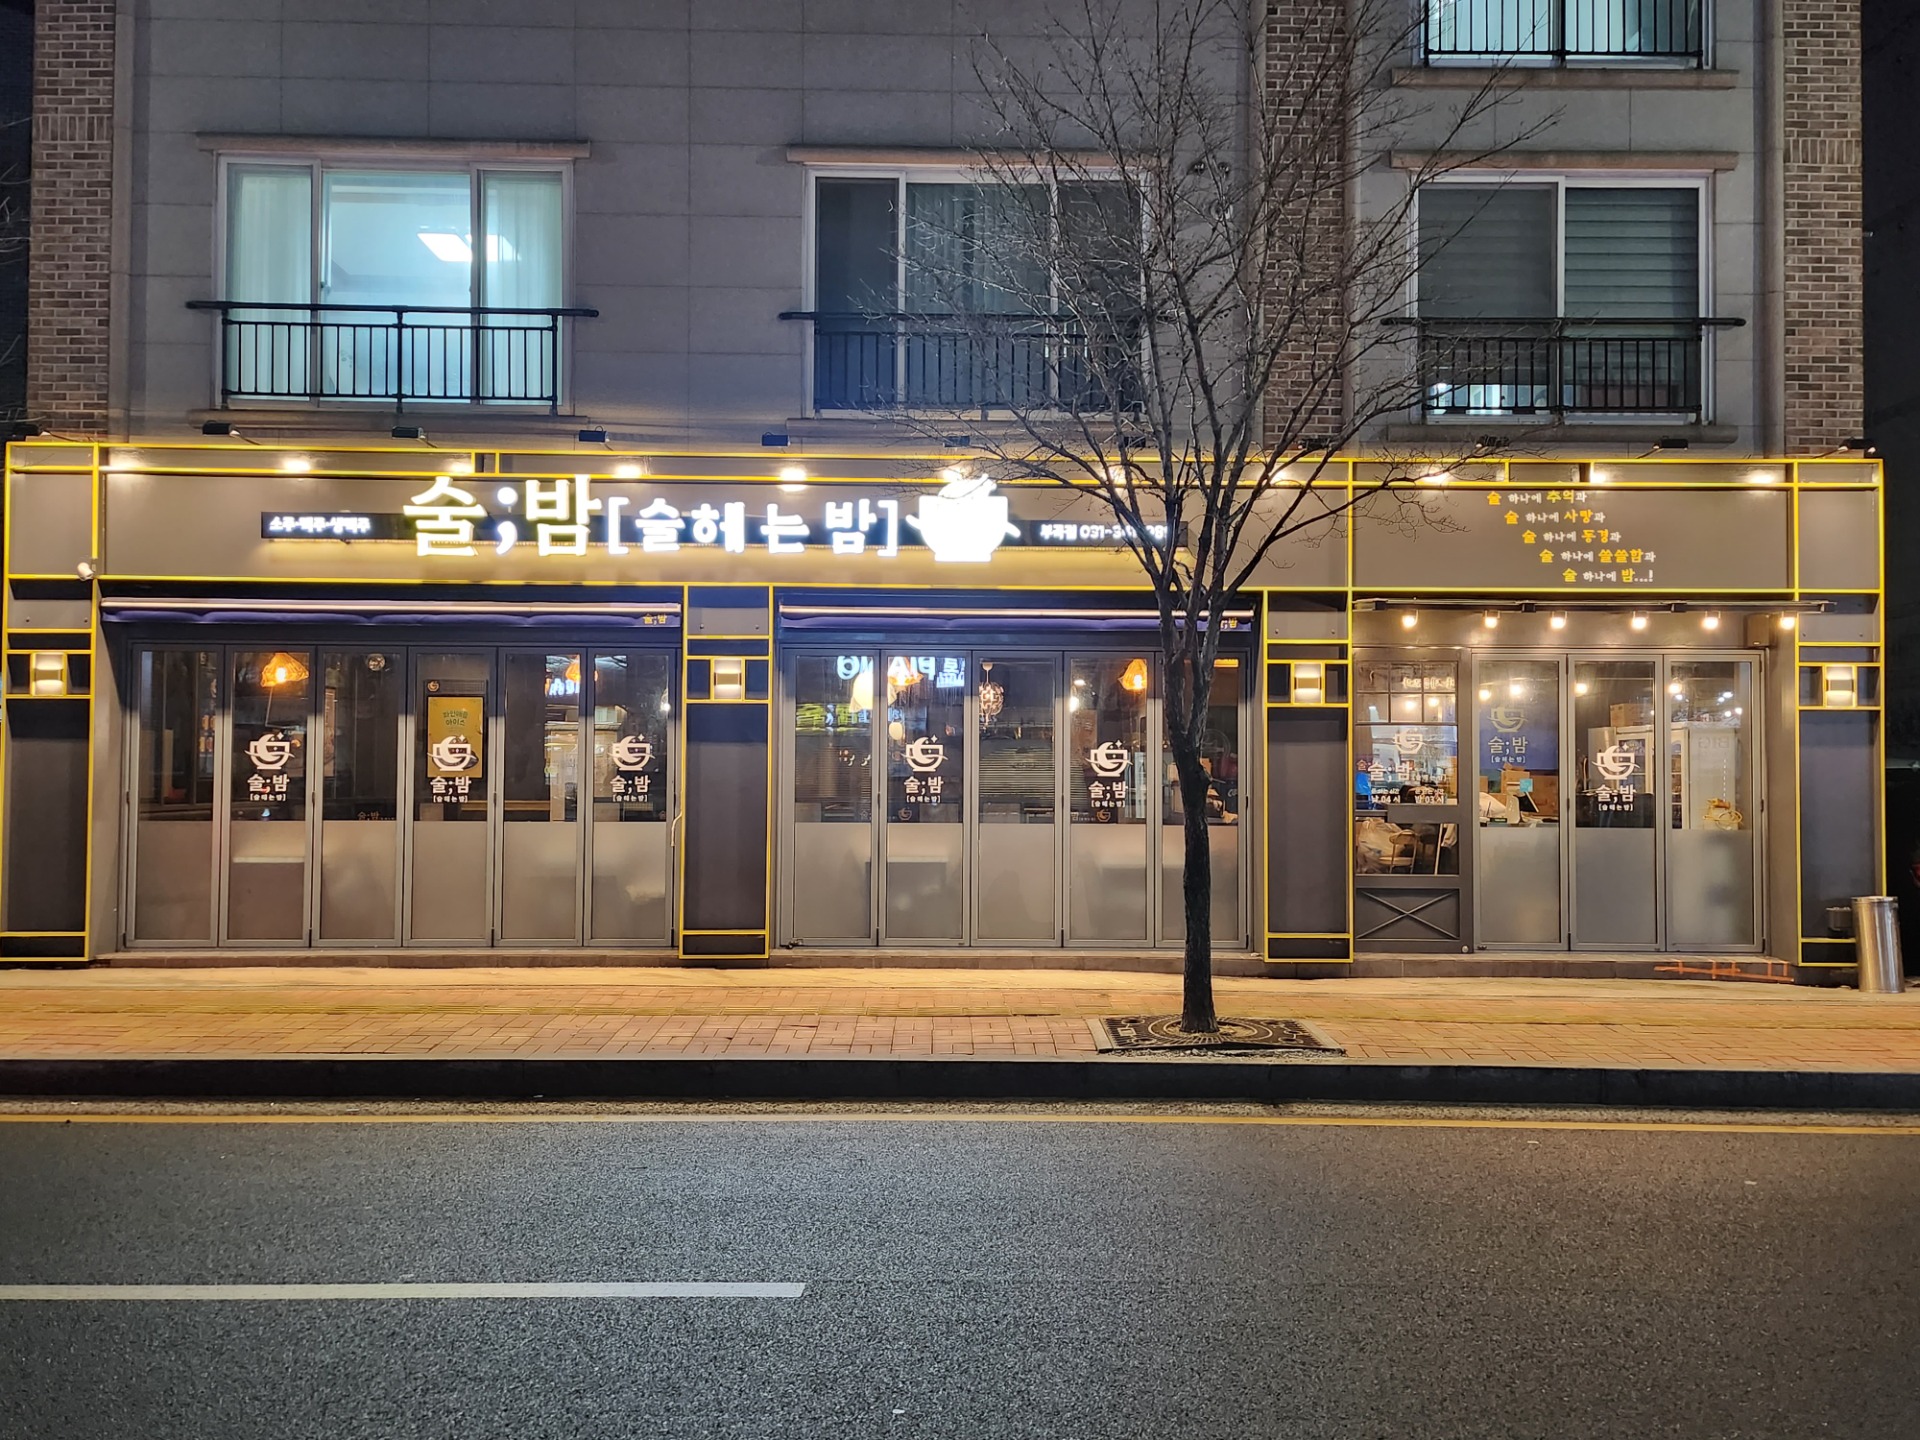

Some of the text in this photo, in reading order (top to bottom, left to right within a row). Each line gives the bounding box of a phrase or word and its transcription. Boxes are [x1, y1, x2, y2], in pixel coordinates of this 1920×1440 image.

[1487, 489, 1587, 505] 술 하나에 추억과
[1504, 509, 1605, 524] 술 하나에 사랑과
[1522, 529, 1621, 544] 술 하나에 동경과
[1539, 549, 1656, 563] 술 하나에 쓸쓸함과
[1562, 568, 1577, 582] 술
[1582, 571, 1617, 582] 하나에
[1488, 736, 1528, 754] 술;밤
[247, 774, 289, 793] 술;밤
[430, 775, 471, 794] 술;밤
[610, 775, 651, 794] 술;밤
[903, 776, 944, 794] 술;밤
[1088, 781, 1128, 799] 술;밤
[1595, 784, 1636, 802] 술;밤
